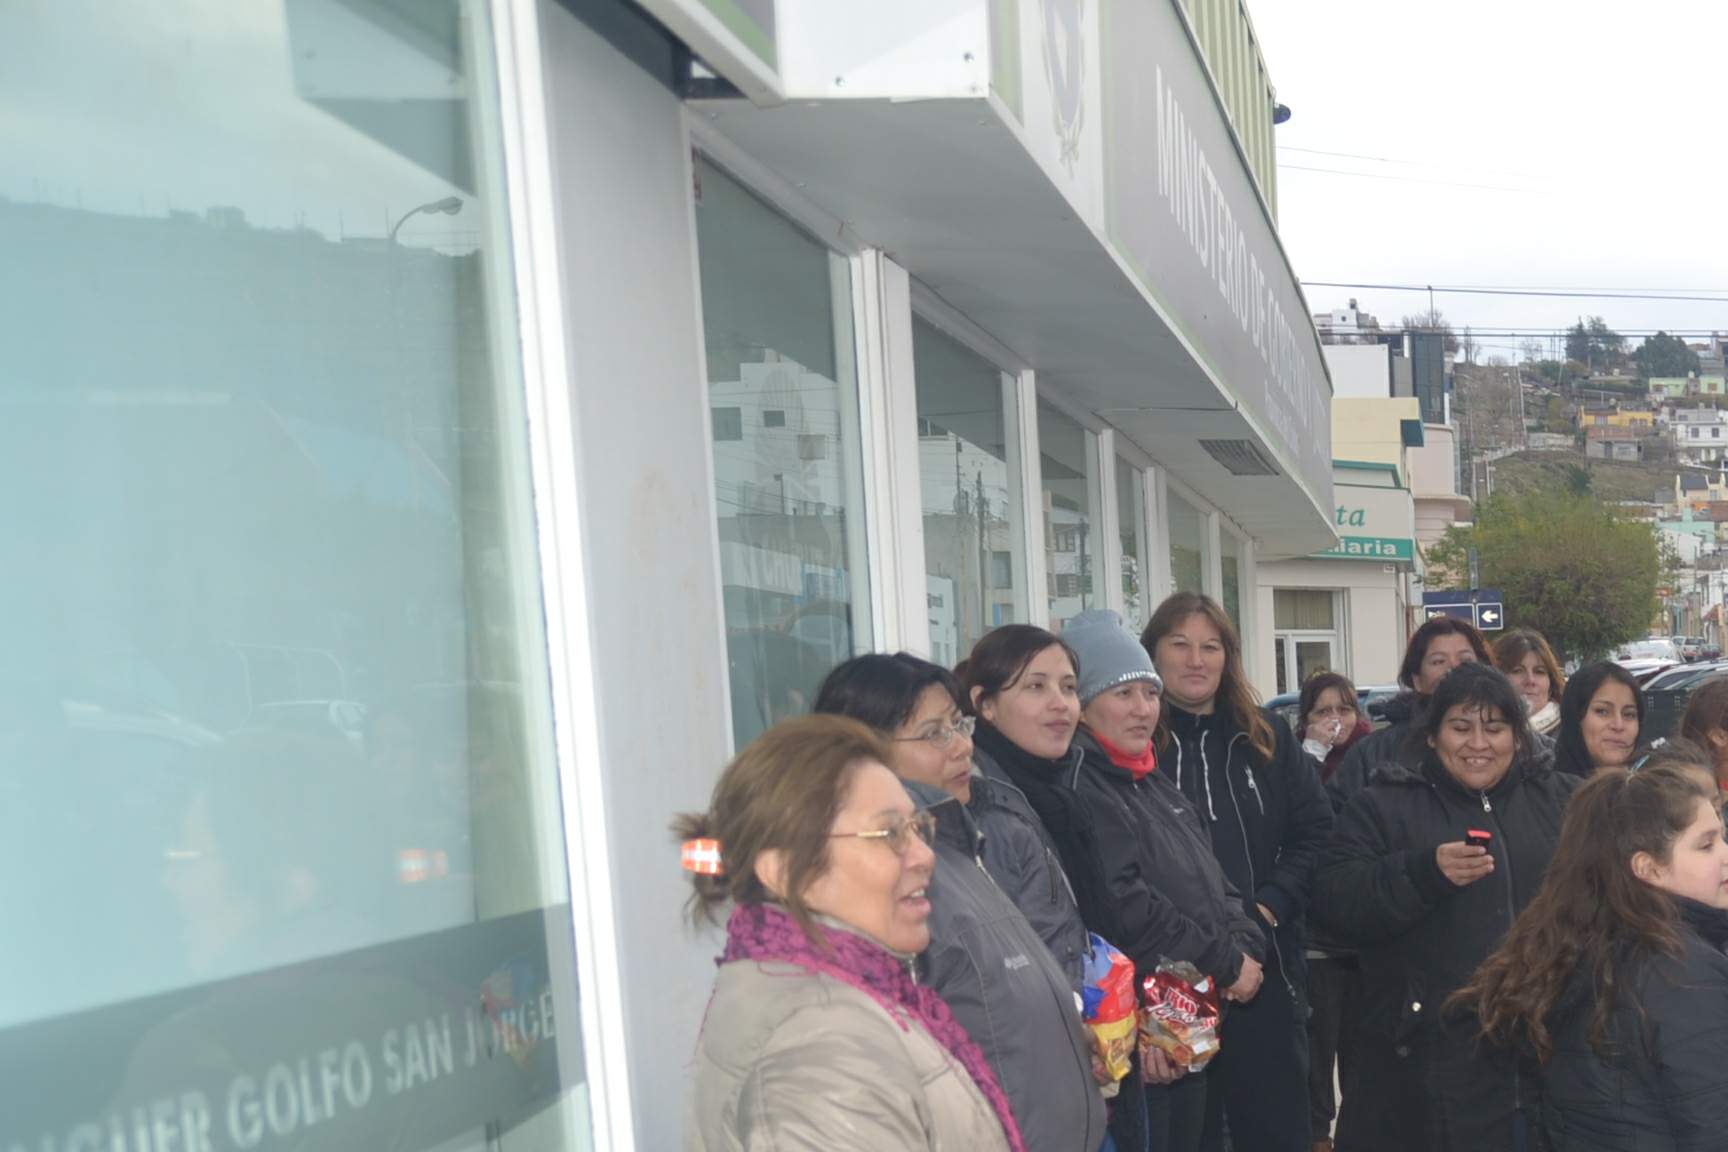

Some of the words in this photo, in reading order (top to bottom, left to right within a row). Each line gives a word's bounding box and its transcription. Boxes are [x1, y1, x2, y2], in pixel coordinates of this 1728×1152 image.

[1155, 62, 1249, 333] MINISTERIO
[1250, 252, 1268, 364] DE
[227, 1041, 372, 1149] GOLFO
[382, 1014, 454, 1094] SAN
